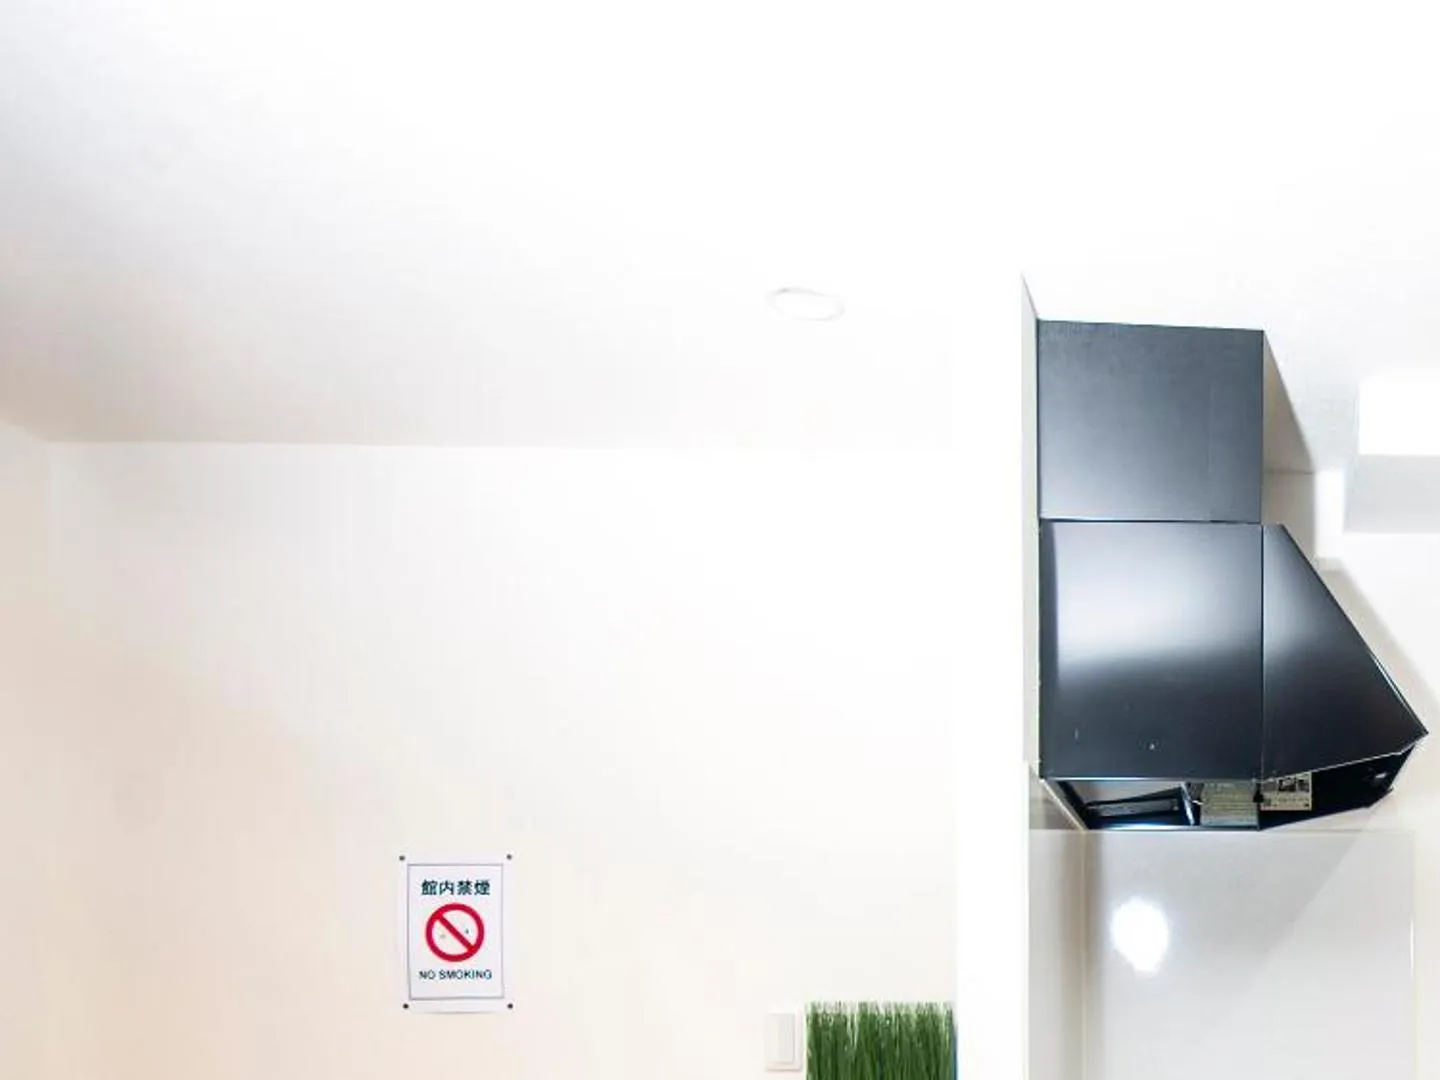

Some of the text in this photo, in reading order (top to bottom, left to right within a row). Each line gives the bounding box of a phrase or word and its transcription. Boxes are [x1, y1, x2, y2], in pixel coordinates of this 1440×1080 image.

[421, 879, 490, 896] 館内禁煙
[419, 969, 492, 980] NO SMOKING
